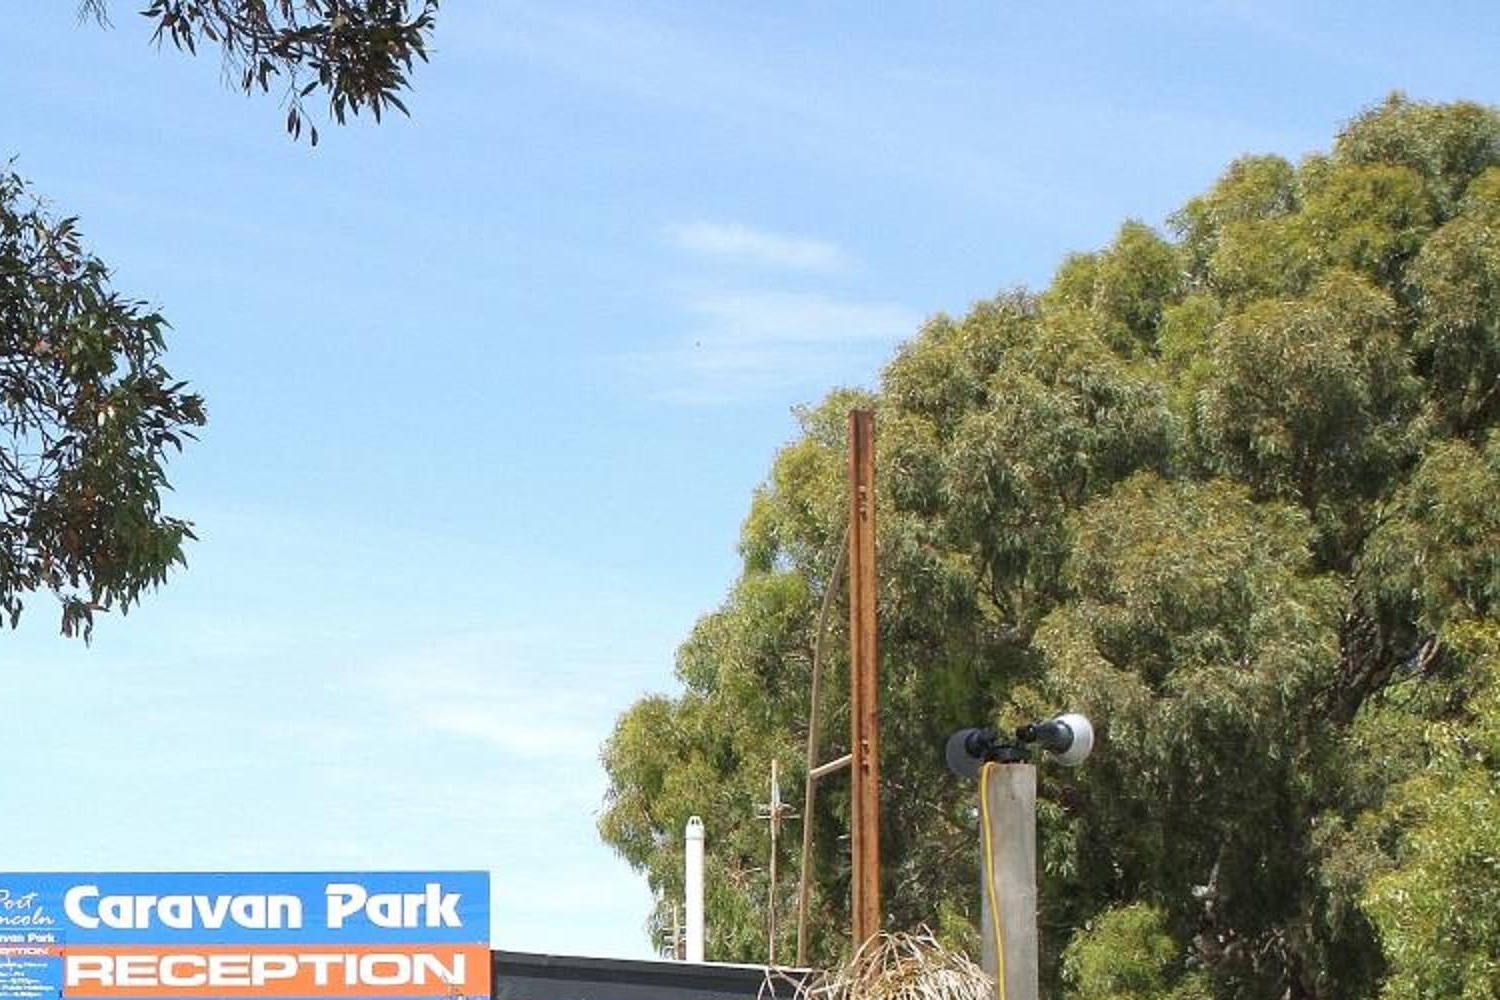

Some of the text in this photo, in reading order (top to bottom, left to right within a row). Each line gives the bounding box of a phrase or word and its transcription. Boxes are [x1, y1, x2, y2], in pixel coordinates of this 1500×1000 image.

[64, 882, 464, 929] Caravan Park
[27, 932, 56, 943] Park
[66, 953, 466, 988] RECEPTION
